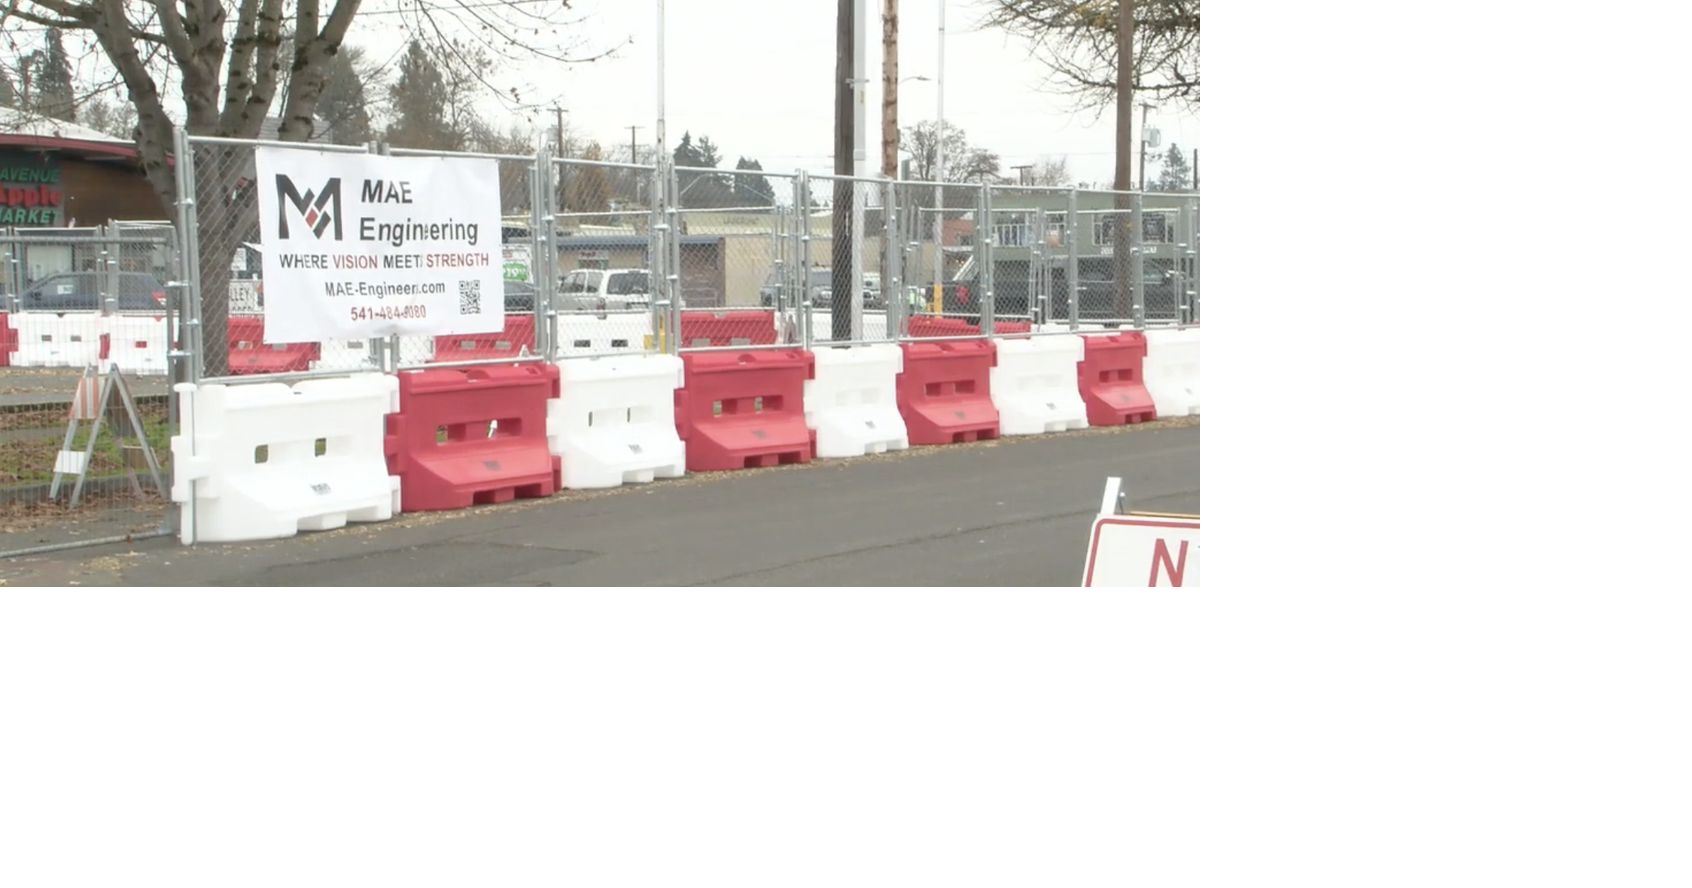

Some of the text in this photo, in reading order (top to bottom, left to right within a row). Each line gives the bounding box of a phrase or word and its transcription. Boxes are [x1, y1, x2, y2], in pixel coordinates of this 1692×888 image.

[0, 167, 60, 182] AVENUE
[361, 179, 413, 204] MAE
[279, 254, 328, 269] WHERE
[332, 254, 378, 269] VISION
[426, 253, 489, 268] STRENGTH
